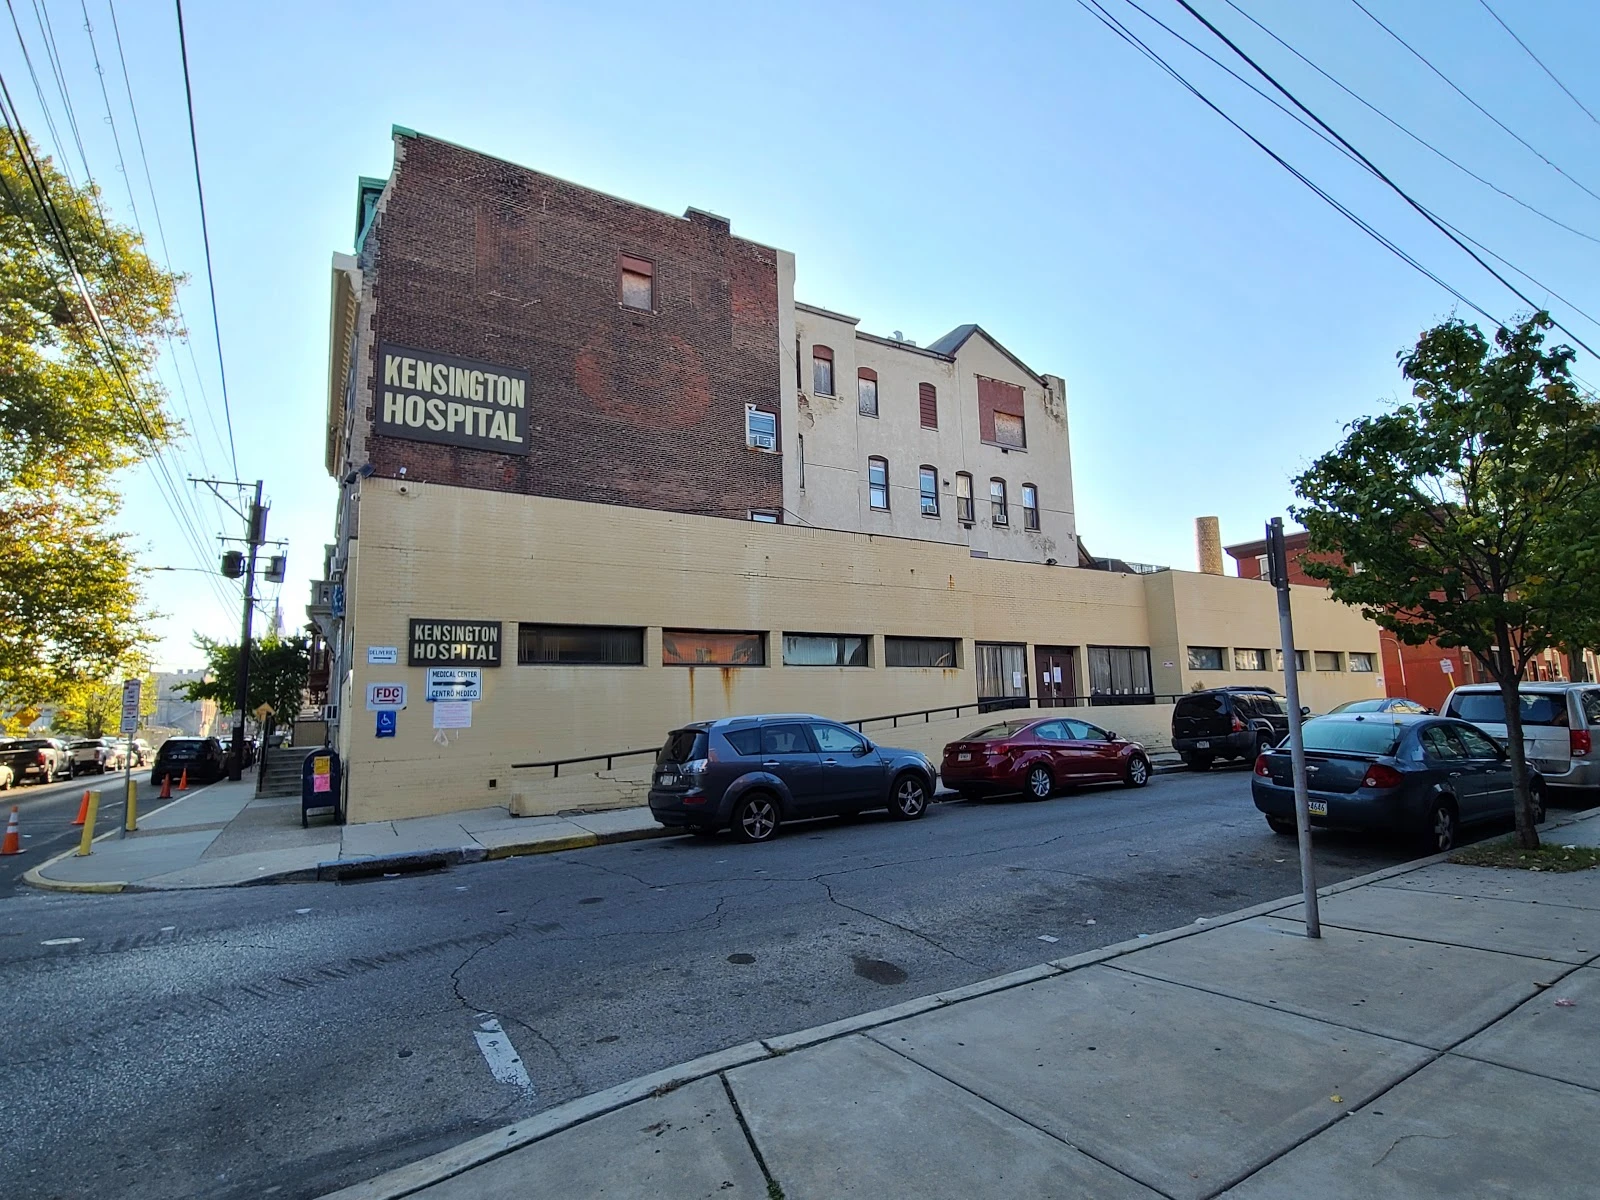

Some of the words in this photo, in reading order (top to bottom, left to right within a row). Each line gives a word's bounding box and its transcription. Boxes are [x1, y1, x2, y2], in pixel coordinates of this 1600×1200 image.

[384, 354, 525, 408] KENSINGTON
[383, 392, 523, 443] HOSPITAL
[414, 624, 498, 642] KENSINGTON
[414, 643, 498, 660] HOSPITAL
[376, 688, 400, 698] FDC
